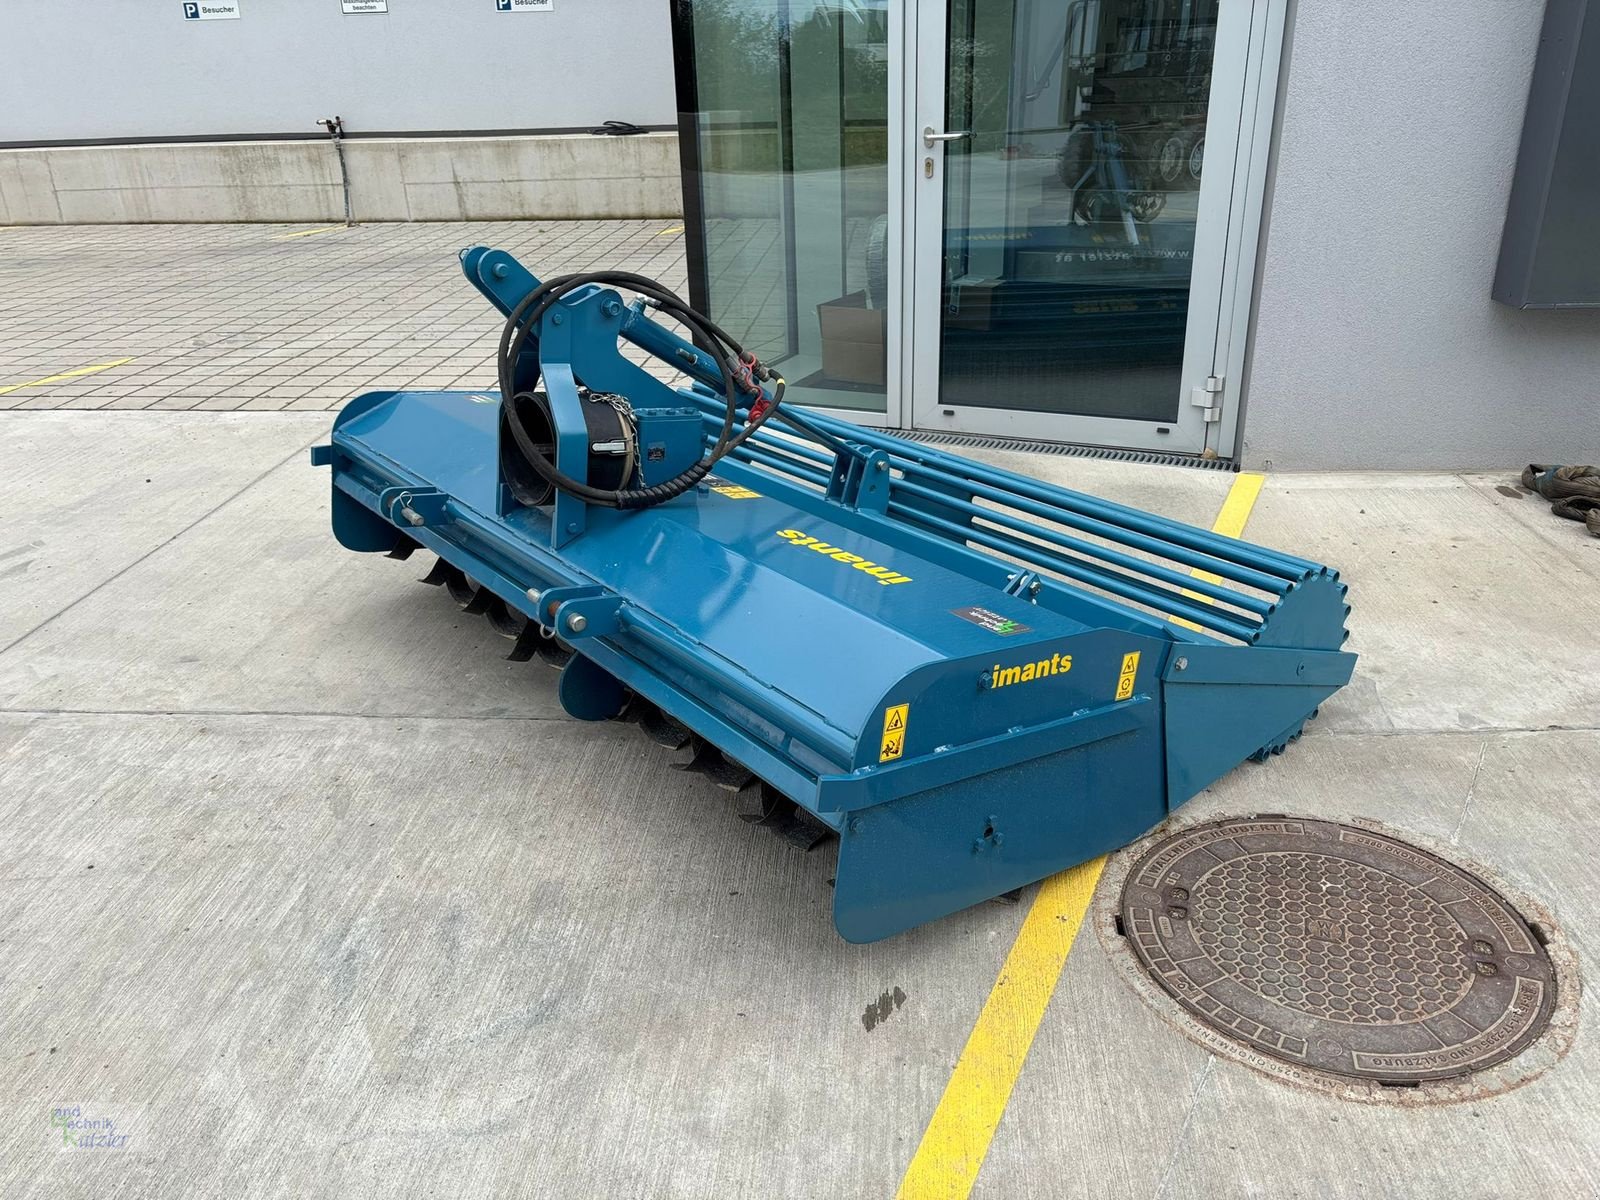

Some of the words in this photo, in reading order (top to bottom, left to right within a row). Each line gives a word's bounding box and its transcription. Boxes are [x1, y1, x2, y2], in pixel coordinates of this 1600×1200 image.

[202, 6, 234, 14] Besucher
[776, 529, 913, 586] imants
[991, 652, 1073, 689] imants
[1147, 839, 1198, 875] WALLNER
[1372, 1054, 1448, 1067] SALZBURG
[1450, 1043, 1482, 1060] LAND
